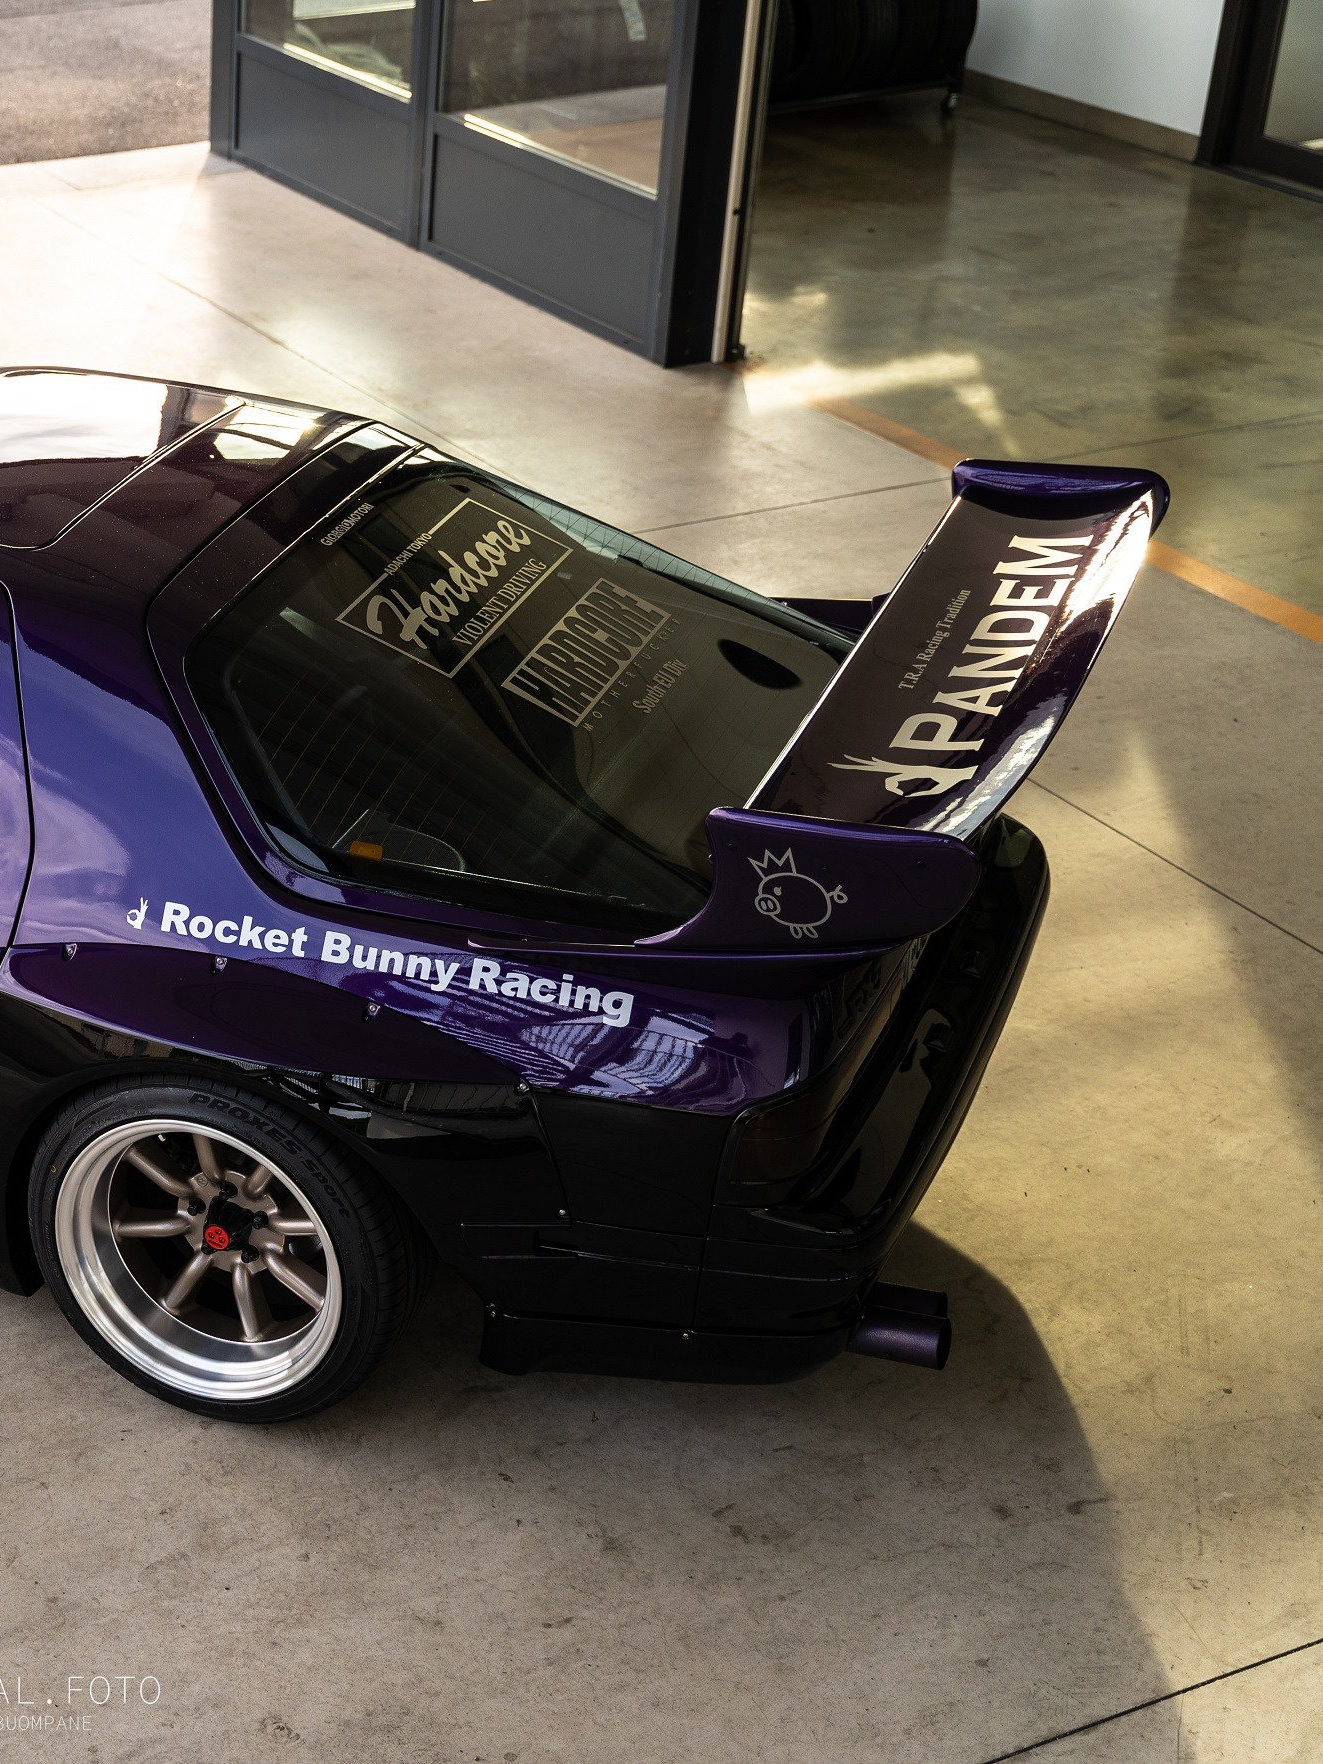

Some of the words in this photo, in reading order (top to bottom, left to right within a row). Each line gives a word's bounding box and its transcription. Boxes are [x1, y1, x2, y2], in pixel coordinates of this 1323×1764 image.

[365, 518, 532, 651] Hardcore
[383, 550, 414, 576] ADACHI
[406, 532, 433, 553] TOKYO
[451, 595, 509, 646] VIOLENT
[496, 557, 548, 602] DRIVING
[507, 579, 666, 725] HARDCORE
[582, 617, 683, 732] MOTHERFUCKER
[631, 684, 667, 714] South
[652, 669, 676, 689] EU
[888, 534, 1095, 753] PANDEM
[897, 663, 928, 689] T.R.A
[916, 630, 951, 662] Racing
[935, 589, 972, 629] Tradition
[159, 900, 308, 958] Rocket
[320, 929, 462, 992] Bunny
[468, 956, 635, 1028] Racing
[188, 1092, 304, 1156] PROXES
